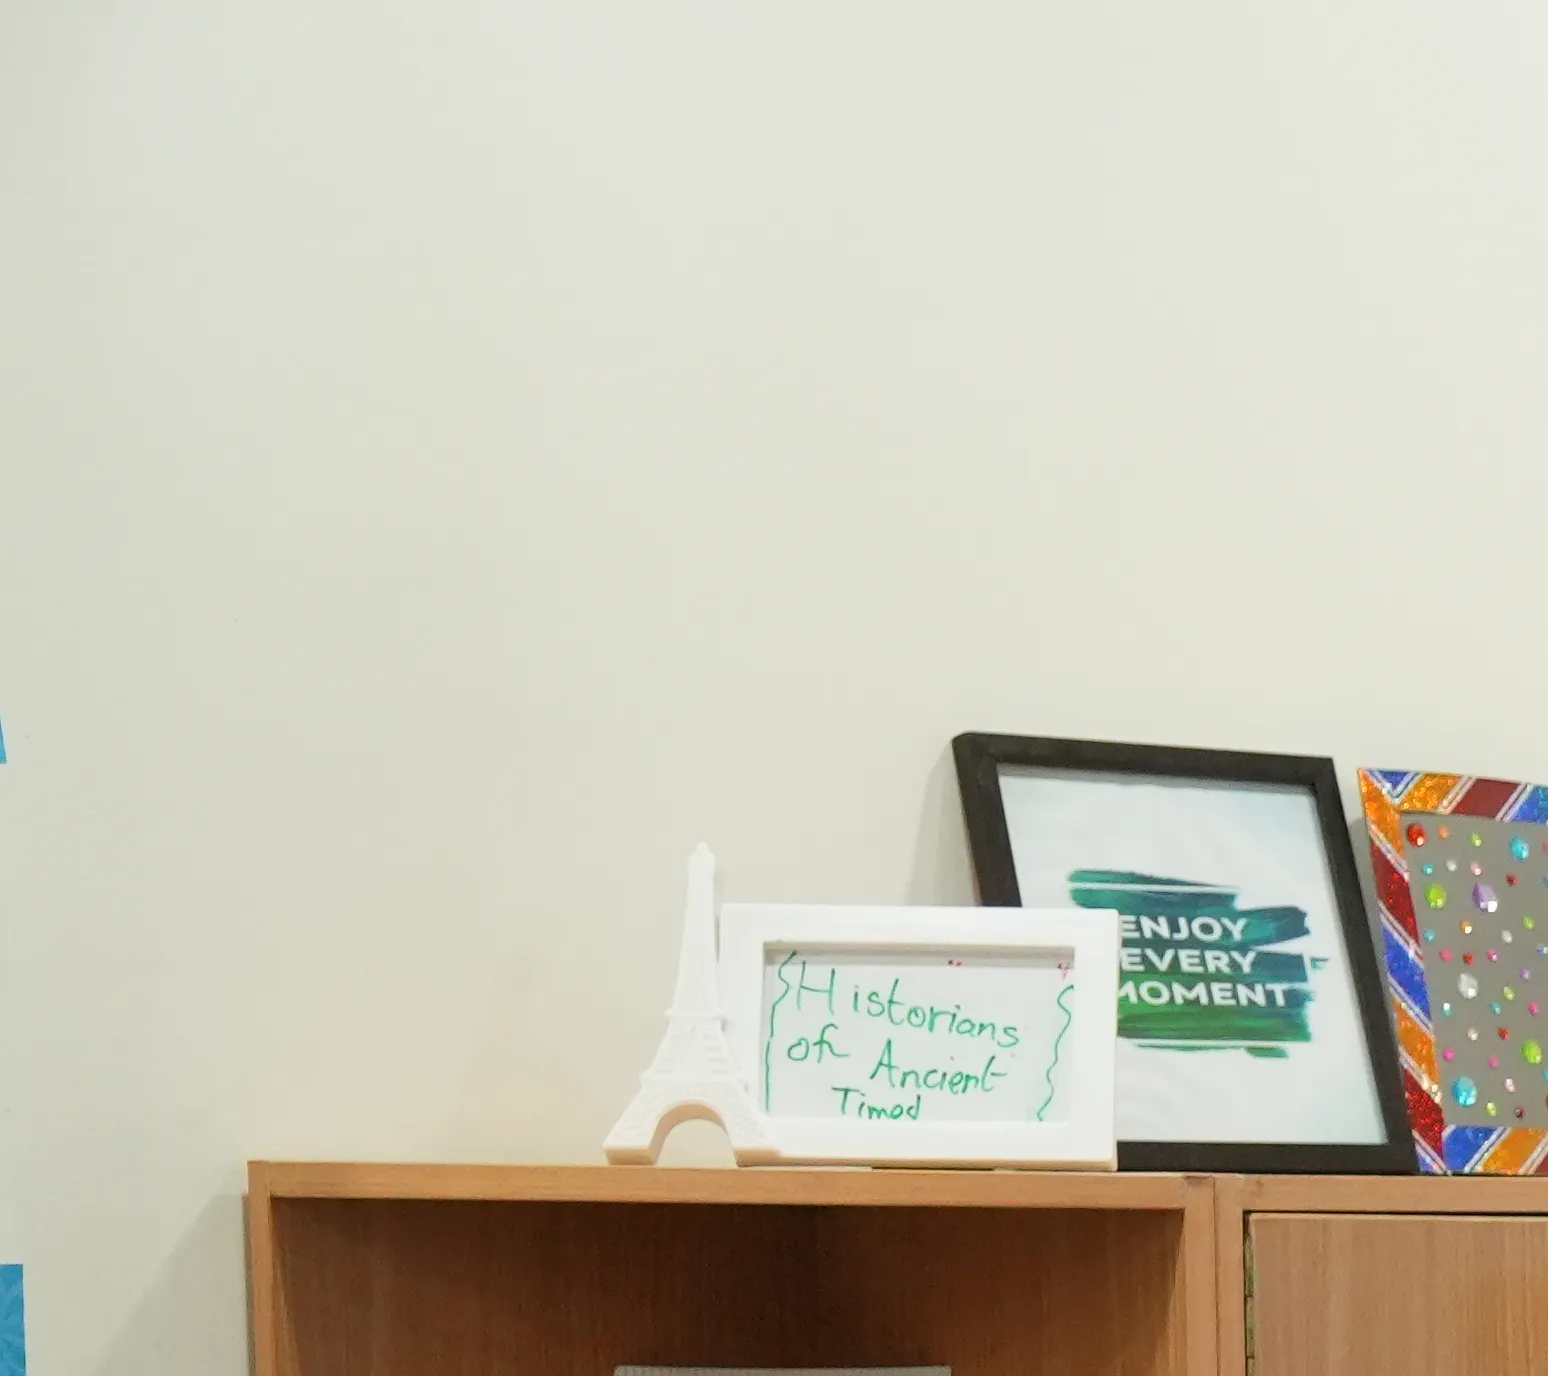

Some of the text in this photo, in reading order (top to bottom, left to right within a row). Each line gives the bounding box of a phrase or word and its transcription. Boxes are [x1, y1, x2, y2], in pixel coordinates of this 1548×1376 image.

[1119, 914, 1248, 942] ENJOY
[1120, 946, 1258, 975] EVERY
[797, 960, 1020, 1047] Historians
[1117, 980, 1288, 1007] MOMENT
[787, 1023, 1008, 1094] of Ancient
